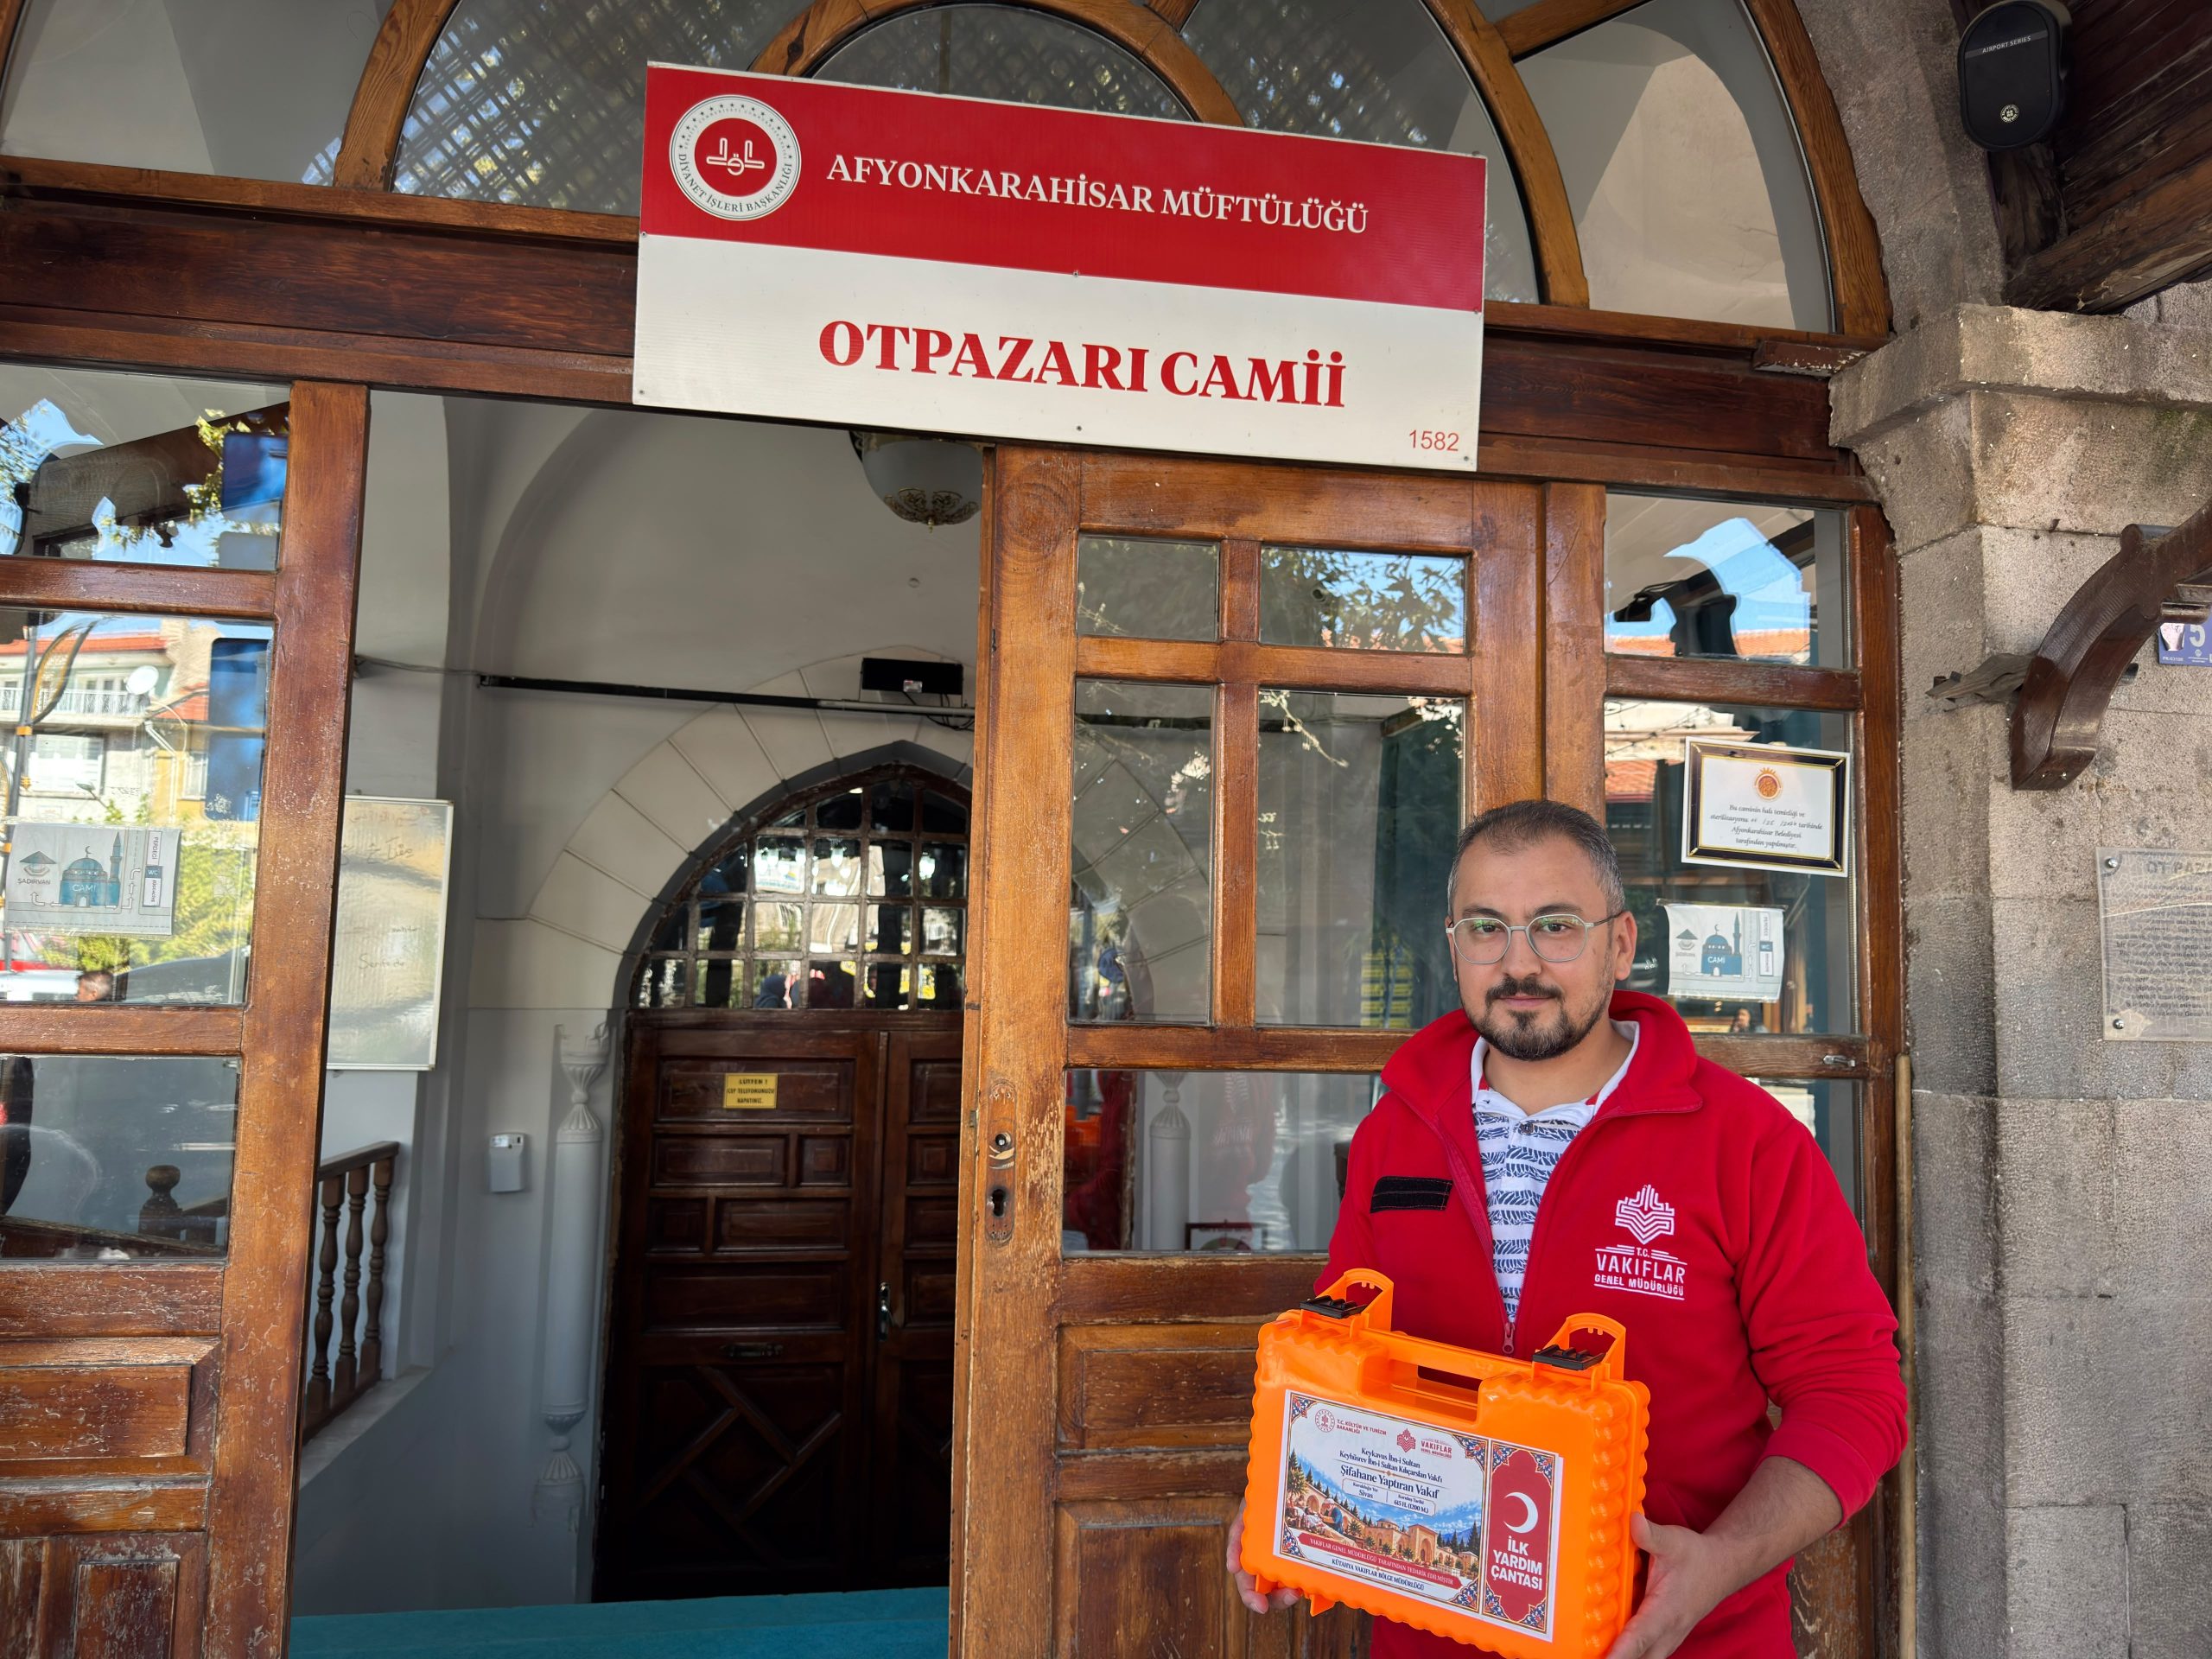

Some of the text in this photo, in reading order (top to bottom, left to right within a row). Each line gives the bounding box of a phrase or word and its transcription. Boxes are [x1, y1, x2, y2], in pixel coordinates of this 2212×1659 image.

[1982, 35, 2031, 54] AIRPORT SERIES
[678, 154, 792, 213] DİYANET İŞLERİ BAŞKANLIĞI
[827, 154, 1370, 234] AFYONKARAHİSAR MÜFTÜLÜĞÜ
[818, 320, 1347, 408] OTPAZARI CAMİİ
[1409, 429, 1459, 451] 1582
[1637, 1247, 1649, 1258] T.C.
[1597, 1253, 1686, 1284] VAKIFLAR
[1594, 1274, 1684, 1296] GENEL MÜDÜRLÜĞÜ
[1361, 1447, 1388, 1460] Keykavus
[1402, 1457, 1421, 1468] Sultan
[1421, 1440, 1452, 1454] VAKIFLAR
[1382, 1460, 1398, 1471] Sultan
[1340, 1465, 1440, 1499] Şifahane Yaptıran Vakıf
[1359, 1490, 1373, 1498] Sivas
[1508, 1535, 1529, 1555] İLK
[1310, 1538, 1332, 1550] VAKIFLAR
[1332, 1545, 1346, 1554] GENEL
[1348, 1548, 1377, 1563] MÜDÜRLÜĞÜ
[1378, 1558, 1407, 1571] TARAFINDAN
[1408, 1565, 1427, 1577] TEDARİK
[1493, 1549, 1542, 1575] YARDIM
[1332, 1558, 1425, 1591] KÜTAHYA VAKIFLAR BÖLGE MÜDÜRLÜĞÜ
[1491, 1565, 1543, 1591] ÇANTASI
